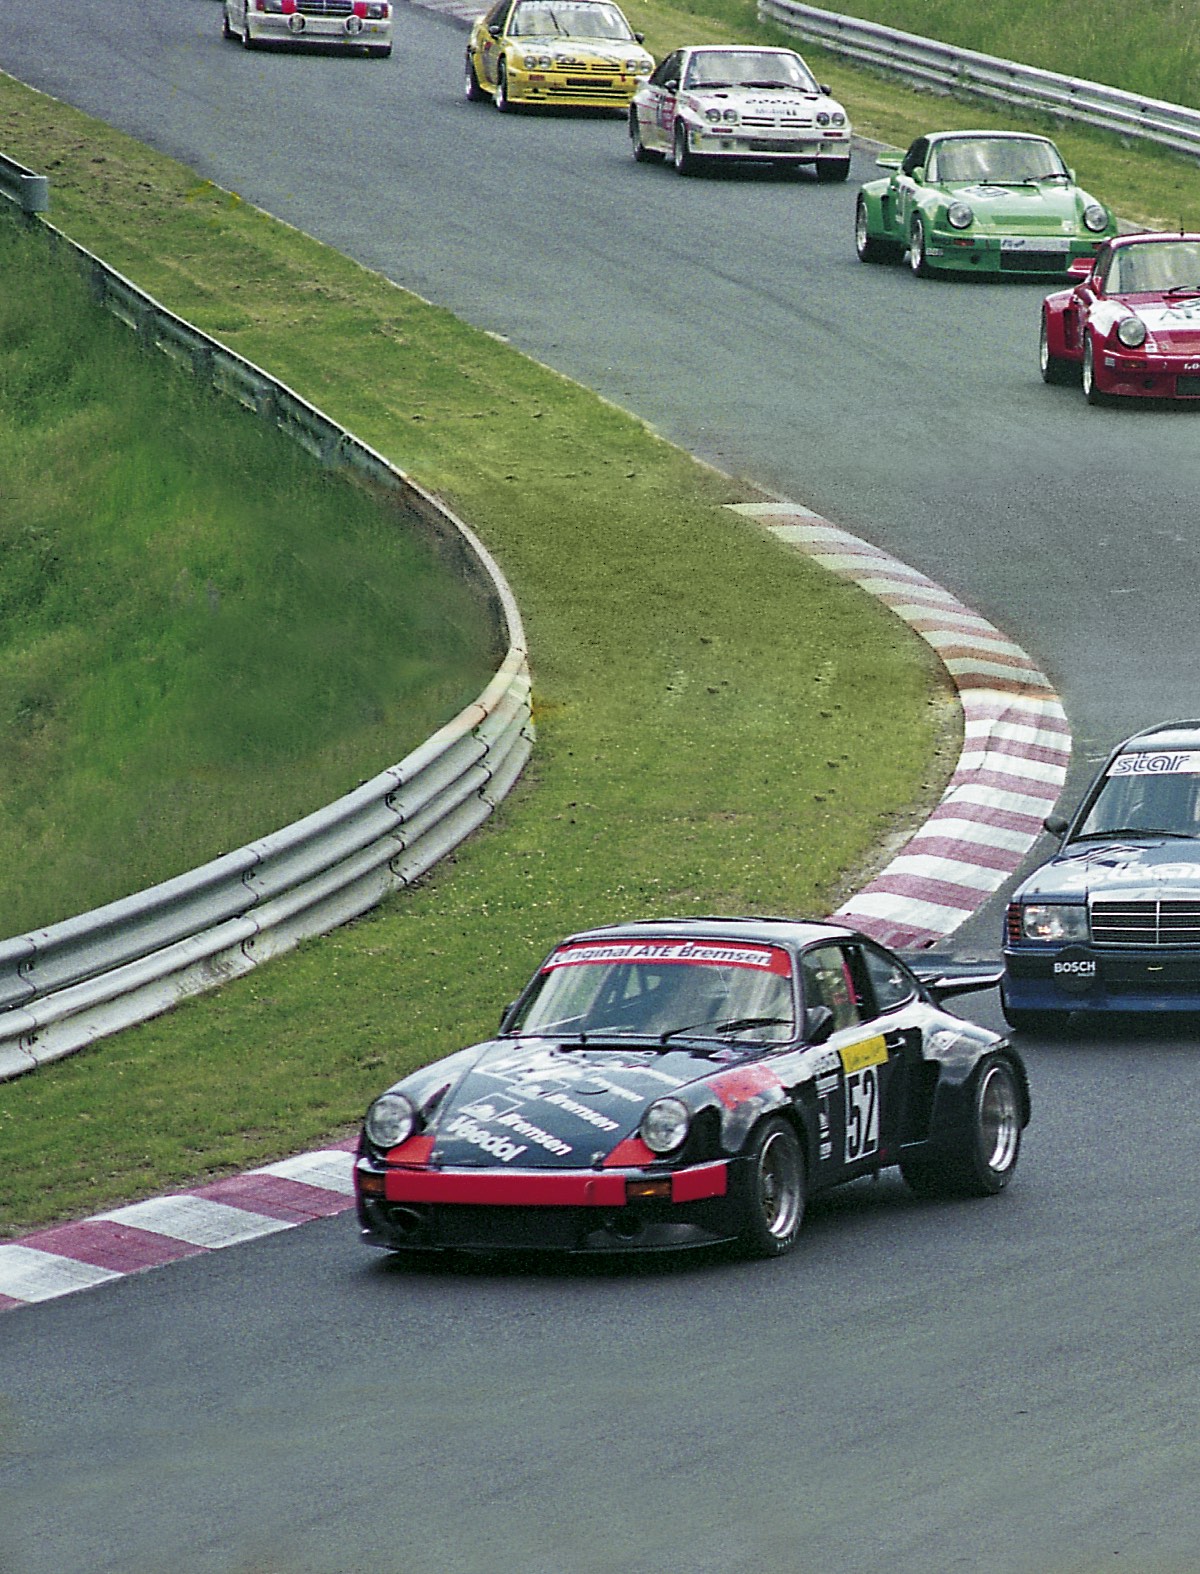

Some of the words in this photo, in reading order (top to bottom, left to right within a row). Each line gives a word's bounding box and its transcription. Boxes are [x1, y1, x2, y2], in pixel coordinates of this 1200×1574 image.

[1113, 753, 1190, 774] star
[634, 945, 675, 957] ATE
[677, 946, 773, 965] Bremsen
[1054, 961, 1096, 973] BOSCH
[847, 1069, 875, 1159] 52
[446, 1115, 528, 1162] Veedol
[497, 1113, 573, 1156] Bremsen
